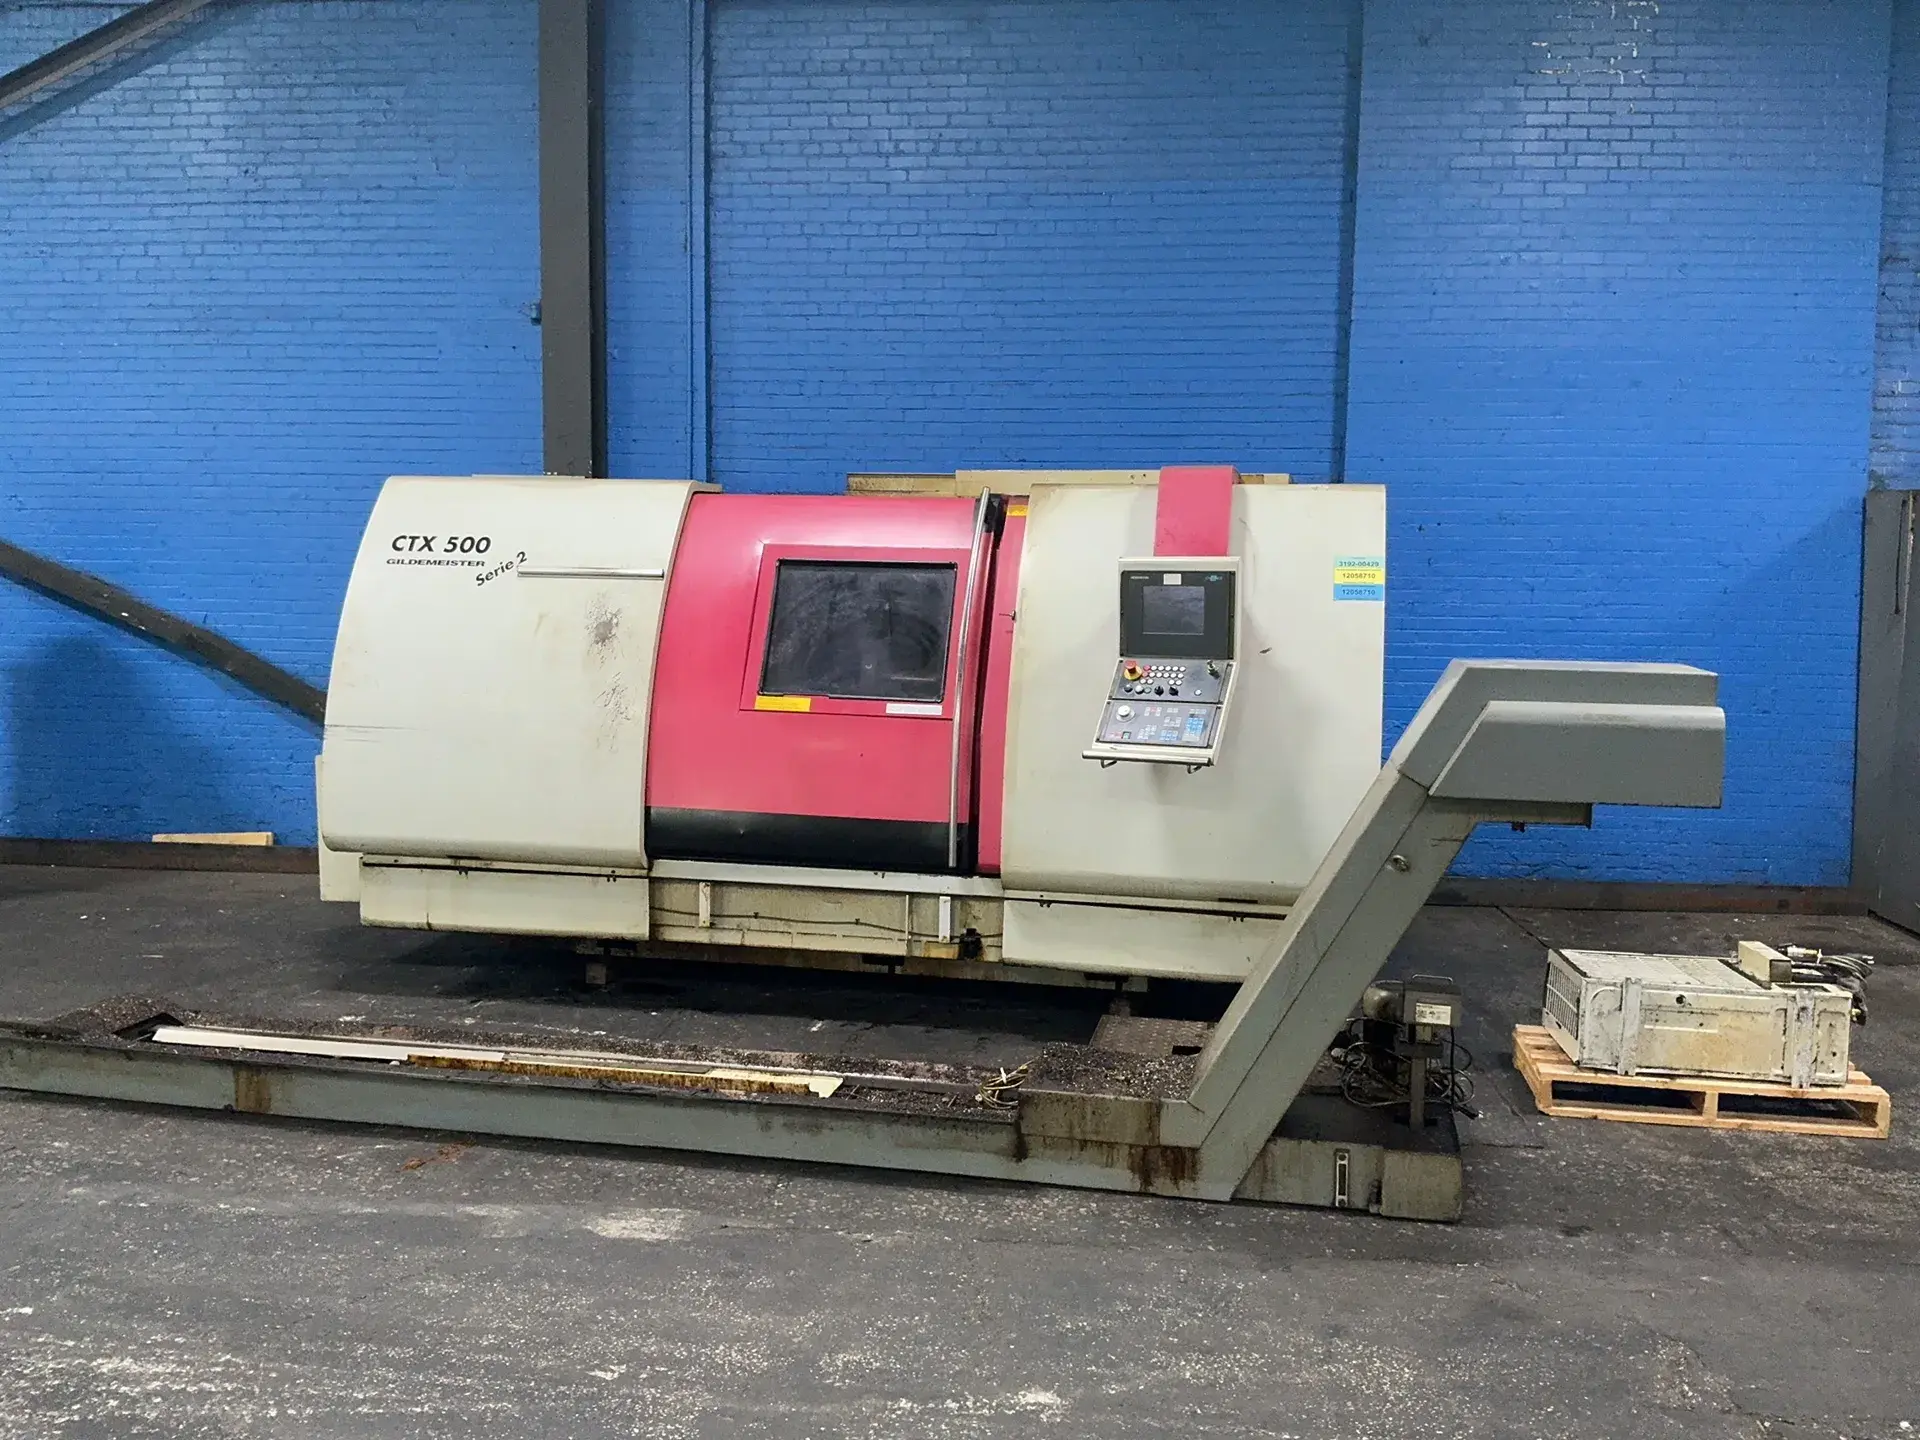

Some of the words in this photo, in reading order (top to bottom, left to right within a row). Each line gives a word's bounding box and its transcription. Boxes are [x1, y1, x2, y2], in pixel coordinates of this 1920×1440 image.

[391, 535, 437, 552] CTX
[443, 536, 491, 553] 500
[386, 558, 486, 567] GILDEMEISTER
[475, 559, 514, 587] Serie
[516, 551, 528, 564] 2
